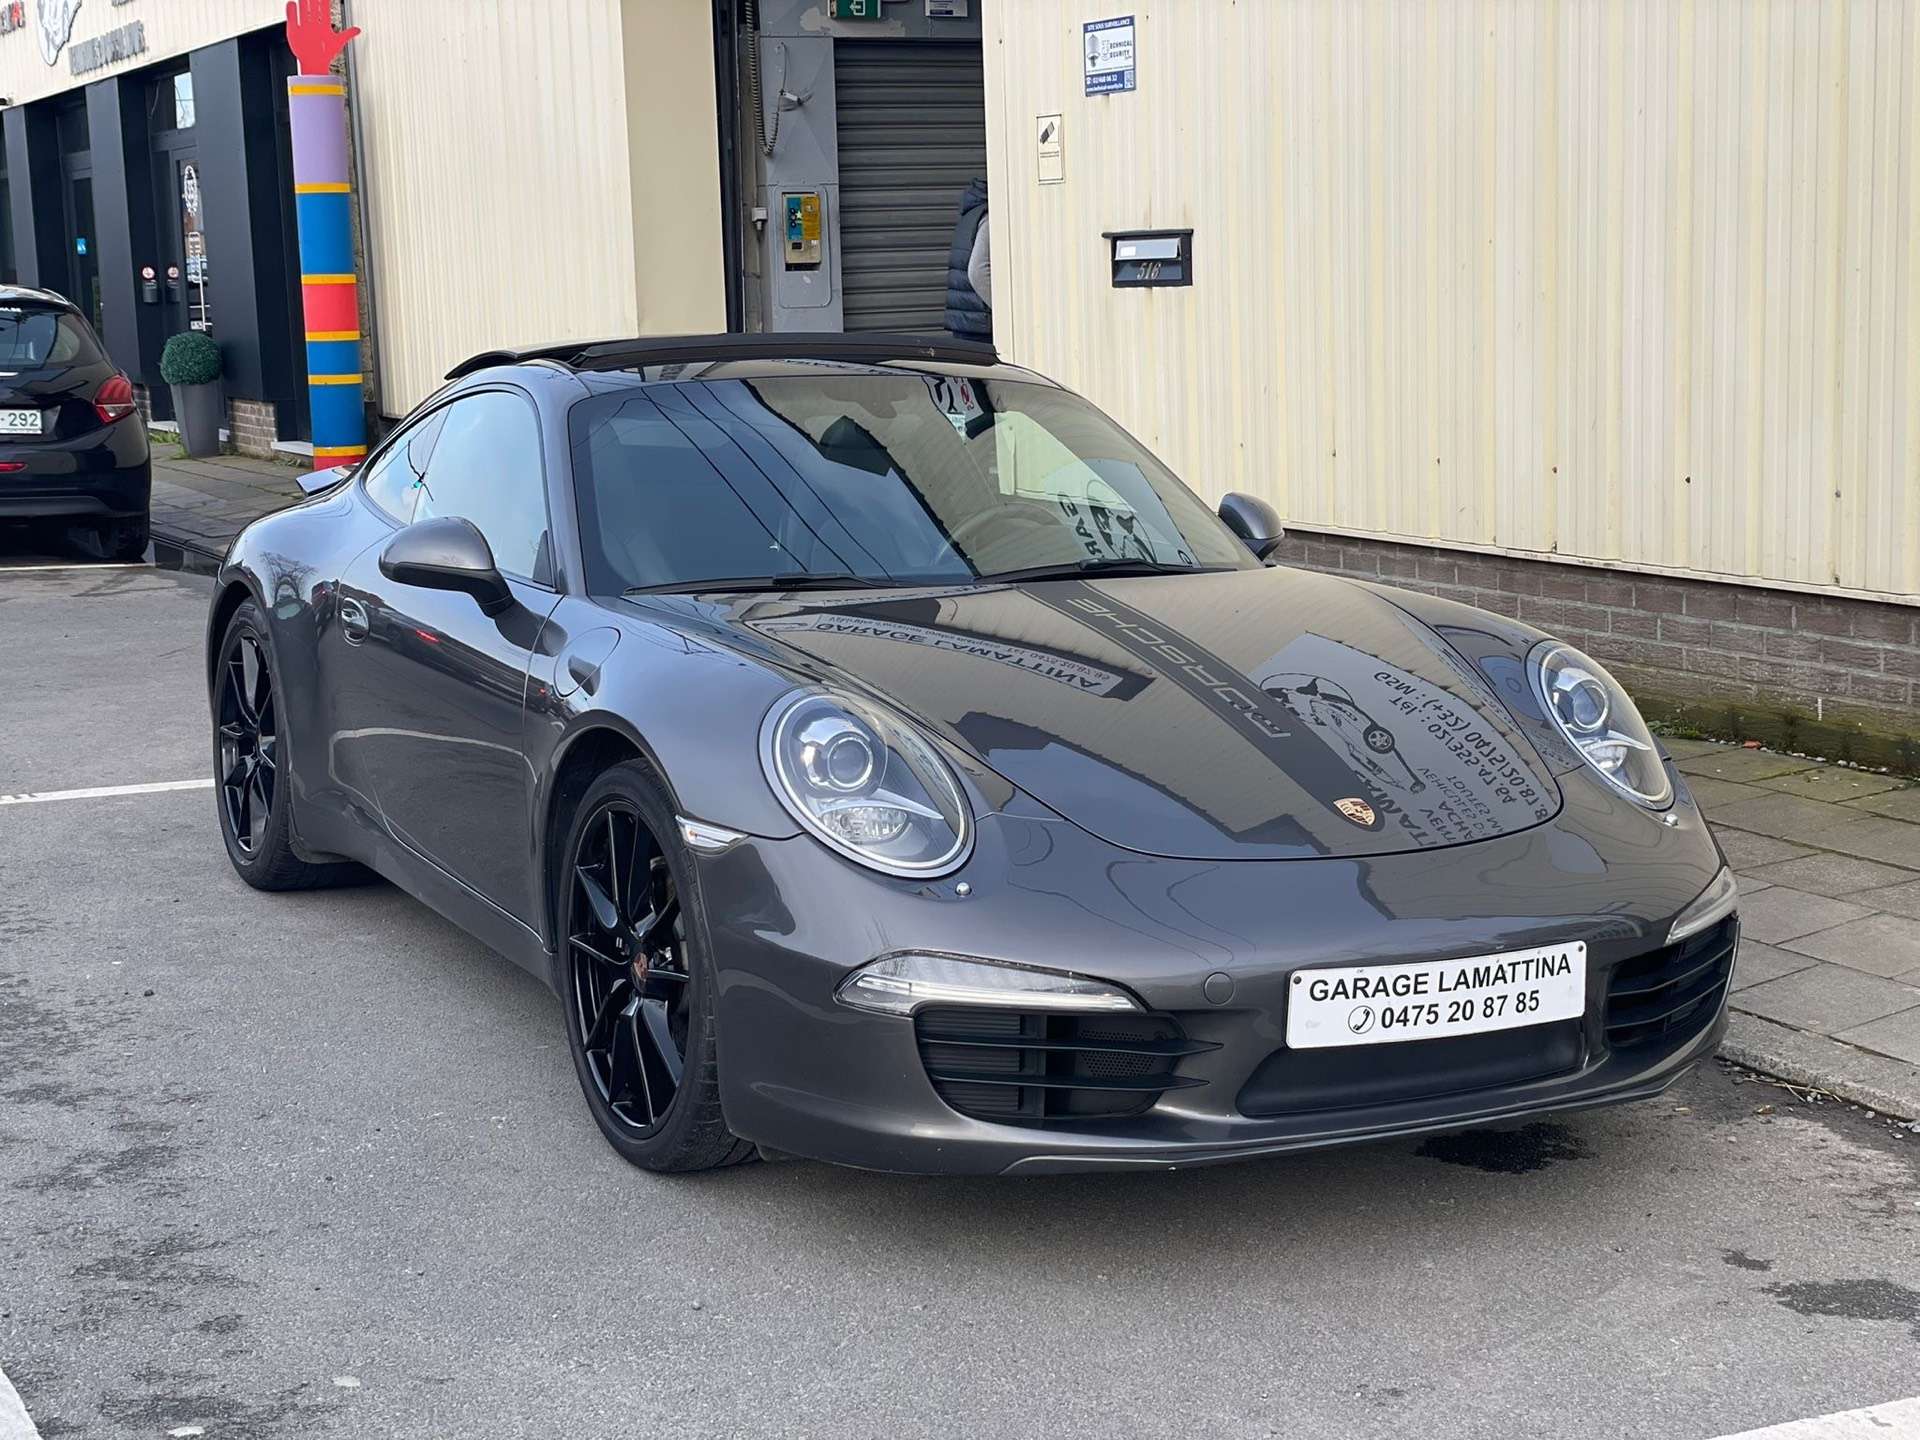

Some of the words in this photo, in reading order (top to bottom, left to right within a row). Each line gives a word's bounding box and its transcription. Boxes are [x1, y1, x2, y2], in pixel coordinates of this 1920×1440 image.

[1066, 598, 1292, 738] PORSCHE
[1309, 972, 1430, 1002] GARAGE
[1438, 952, 1572, 993] LAMATTINA
[1380, 1003, 1440, 1029] 0475
[1447, 999, 1475, 1024] 20
[1482, 995, 1509, 1018] 87
[1515, 989, 1540, 1013] 85
